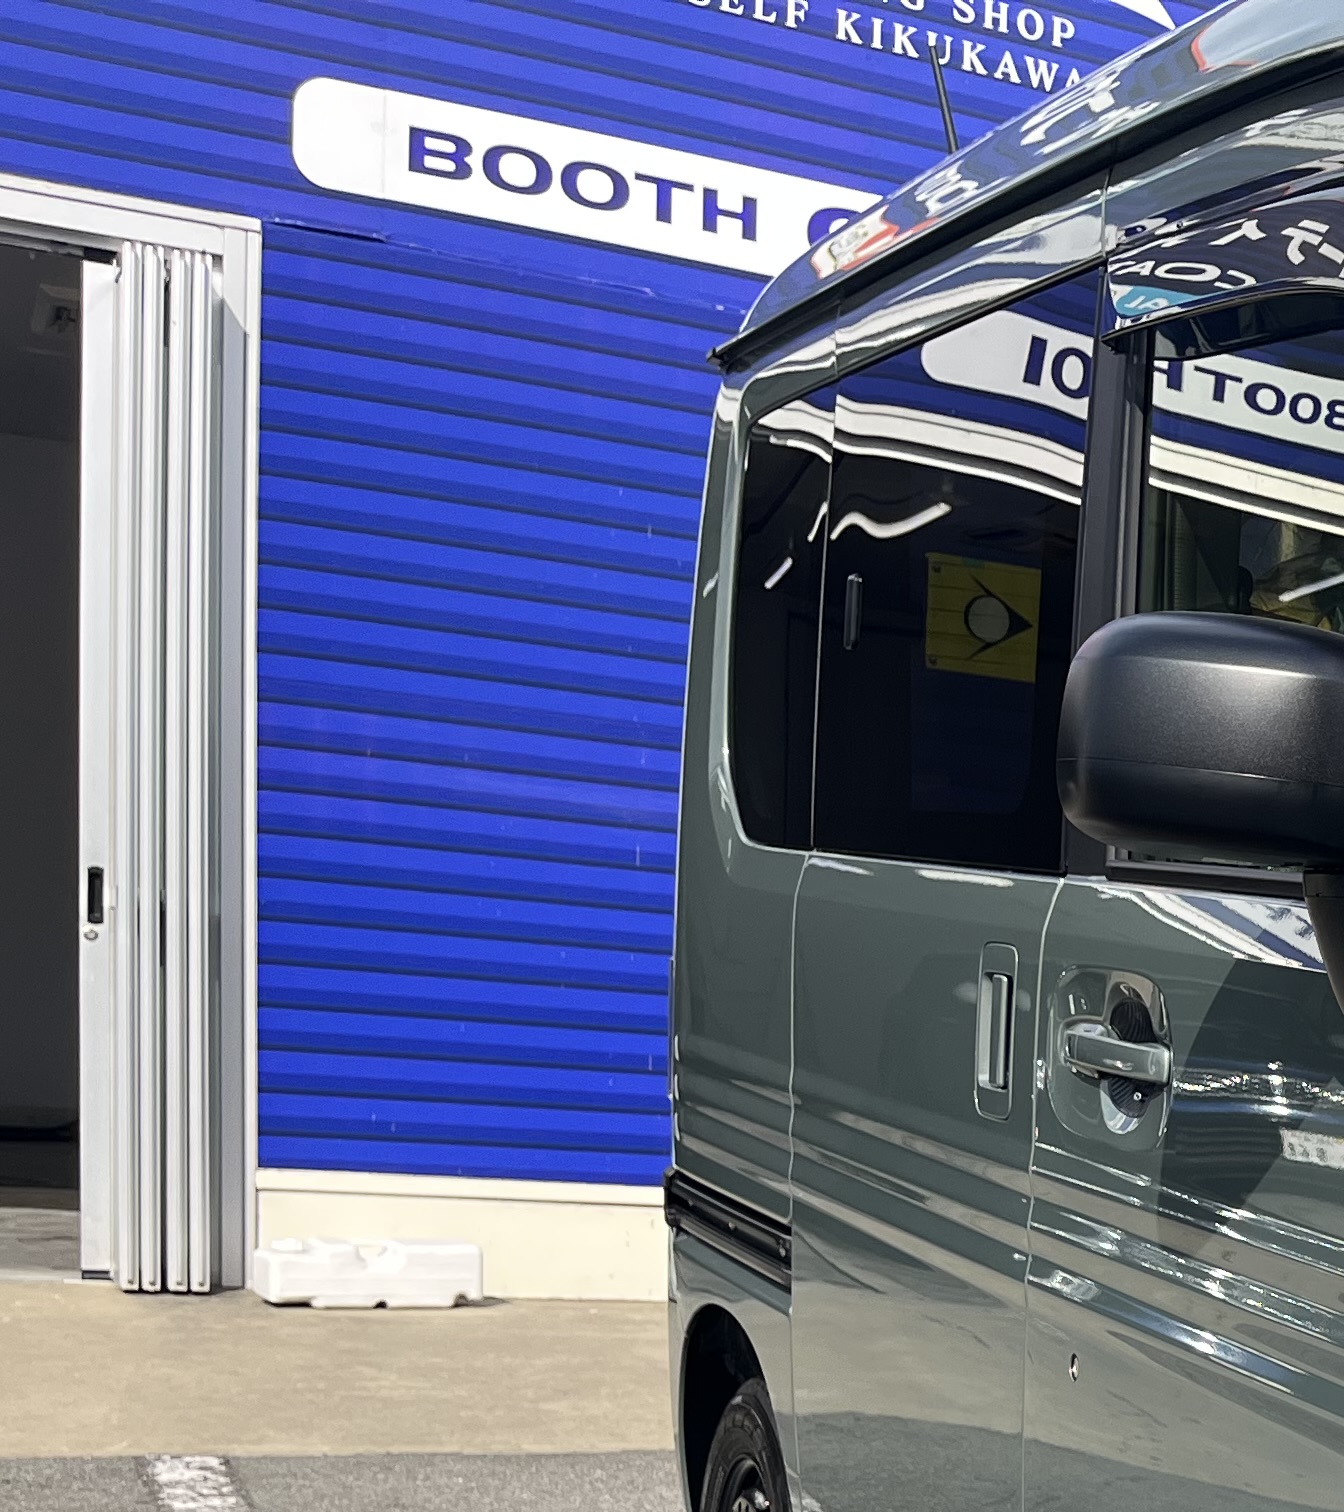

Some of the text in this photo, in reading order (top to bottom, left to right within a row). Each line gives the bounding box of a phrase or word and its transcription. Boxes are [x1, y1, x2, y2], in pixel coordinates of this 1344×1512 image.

[688, 0, 809, 29] ELF
[951, 0, 1076, 48] SHOP
[408, 125, 758, 243] BOOTH
